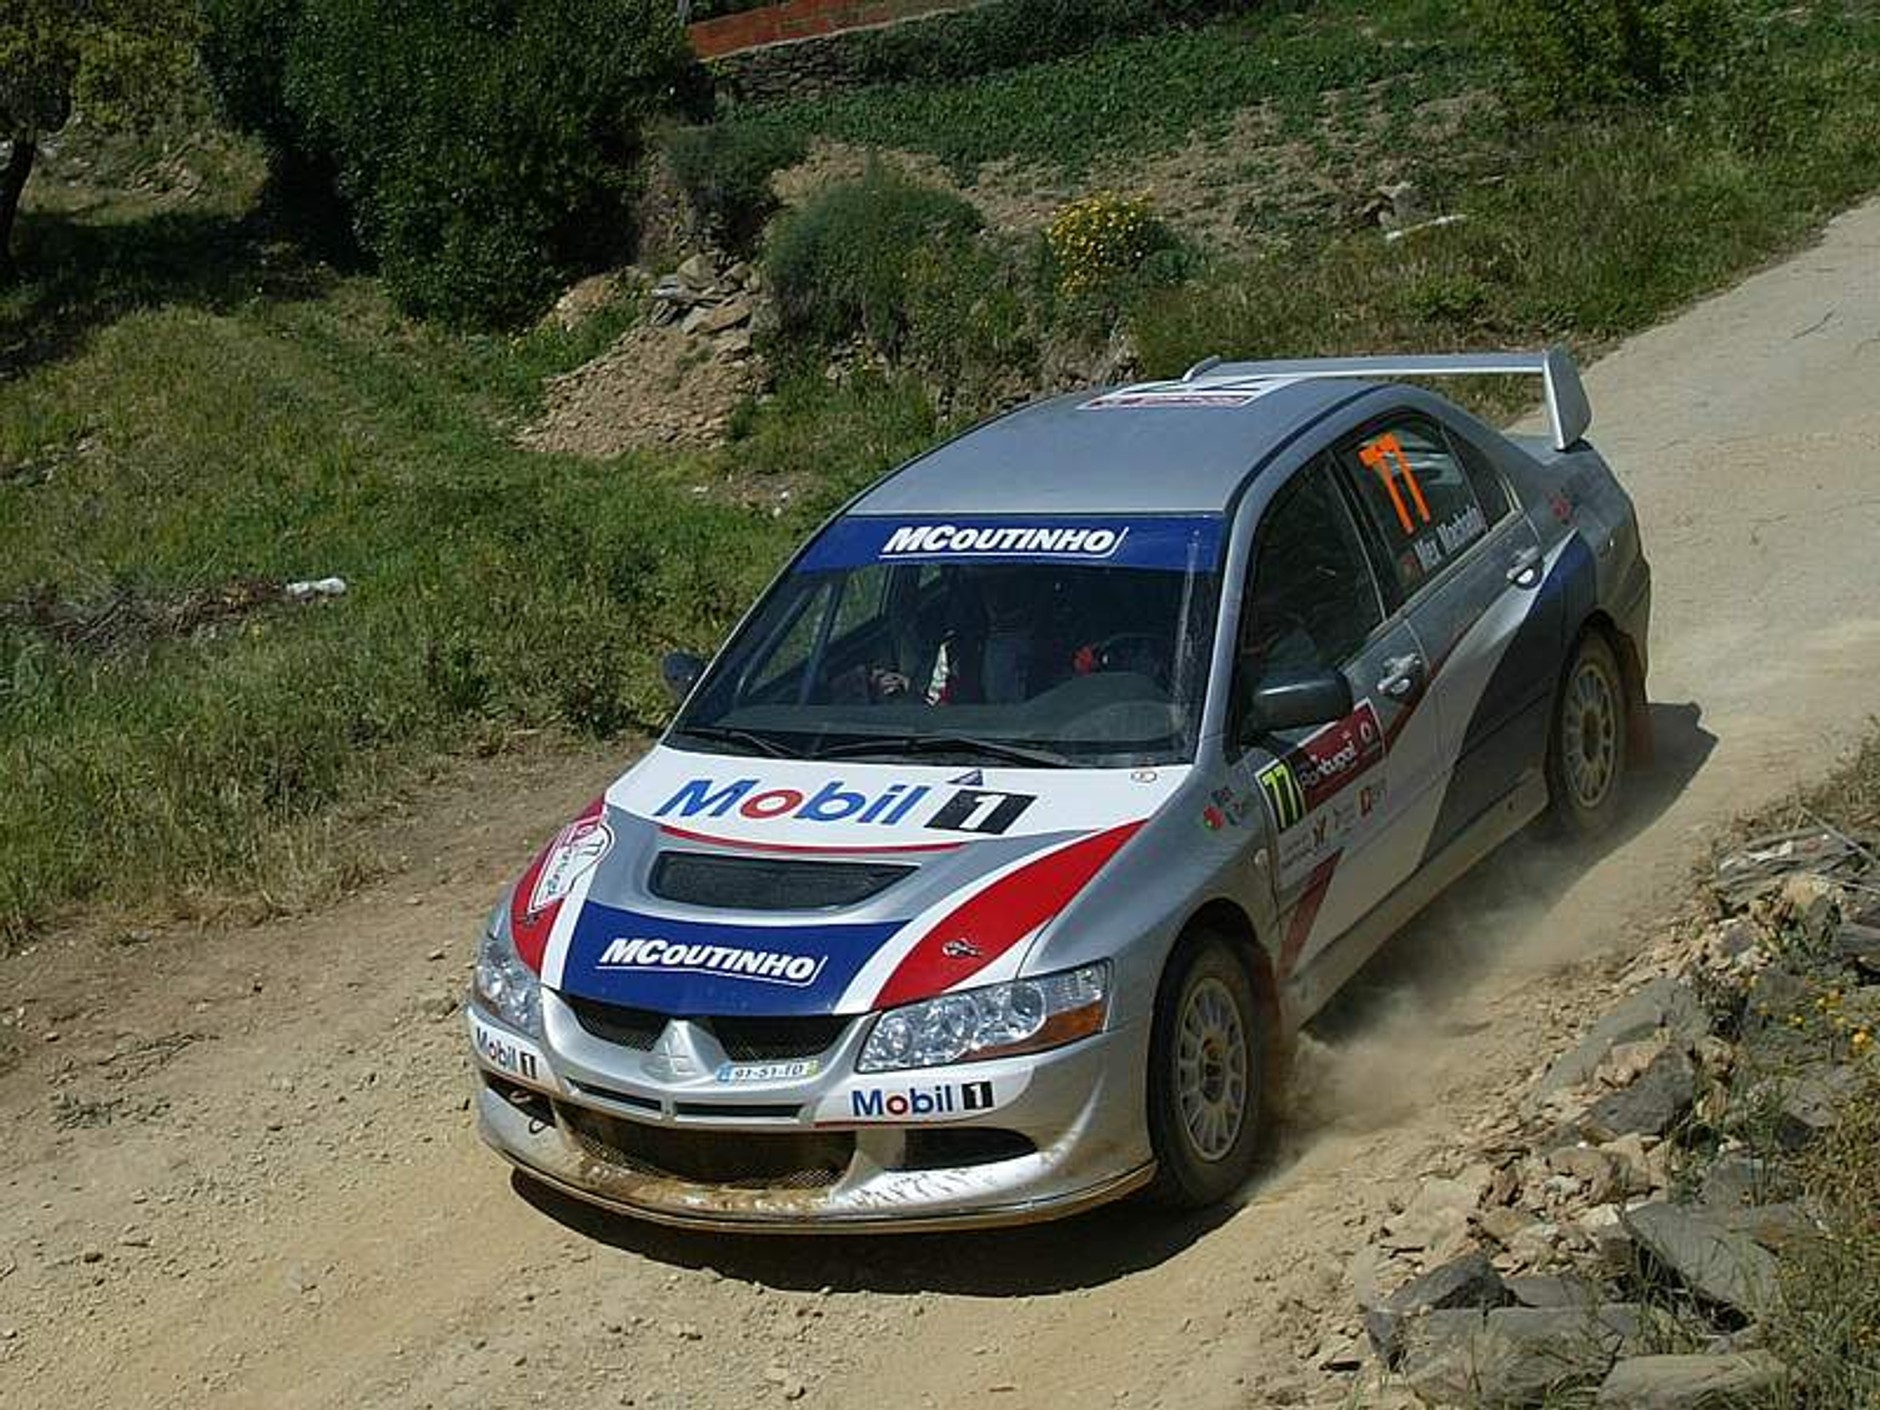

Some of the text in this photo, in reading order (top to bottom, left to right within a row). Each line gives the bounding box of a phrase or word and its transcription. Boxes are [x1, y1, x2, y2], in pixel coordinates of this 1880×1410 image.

[1358, 432, 1431, 535] 77
[653, 779, 931, 824] Mobil
[1262, 764, 1299, 829] 77
[477, 1027, 518, 1073] Mobil
[852, 1085, 953, 1116] Mobil
